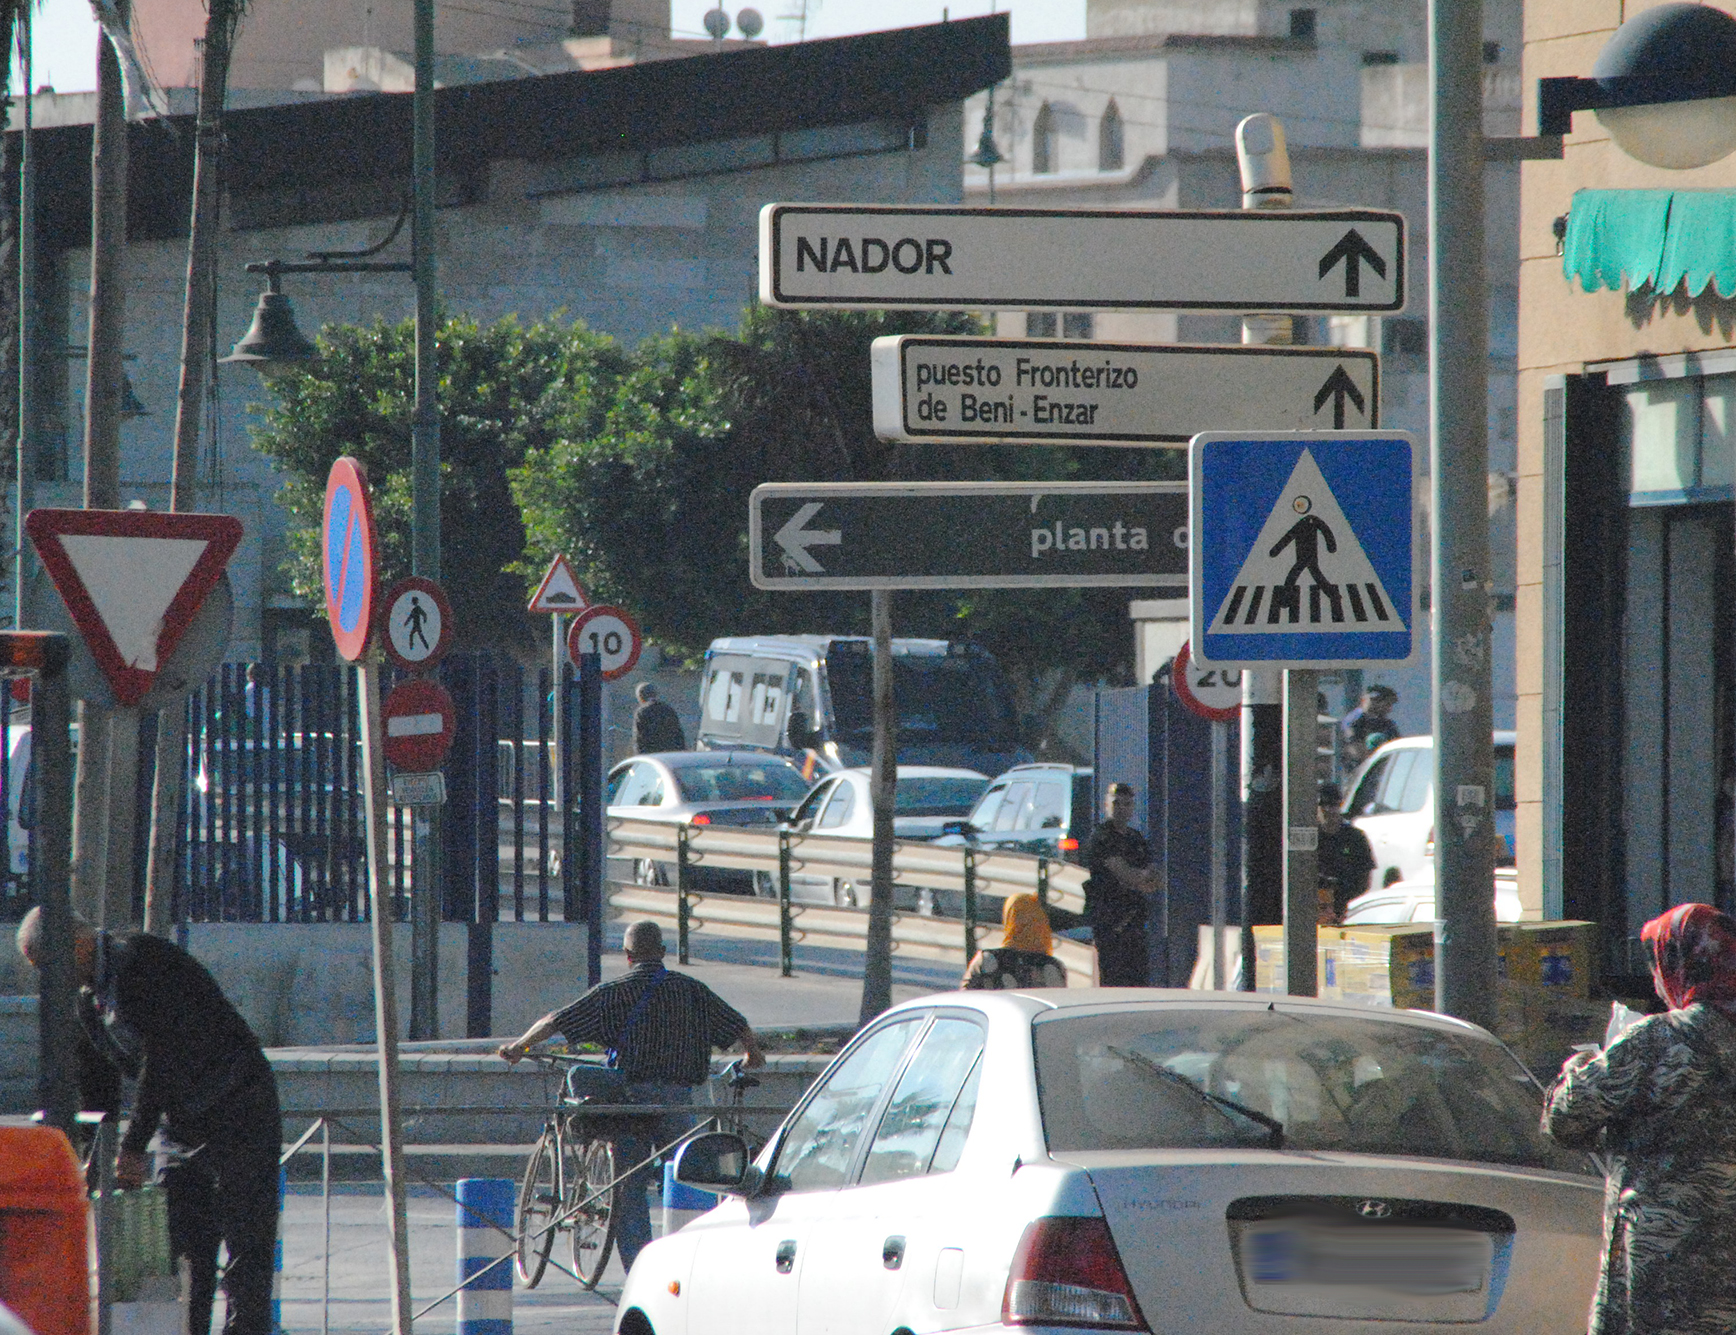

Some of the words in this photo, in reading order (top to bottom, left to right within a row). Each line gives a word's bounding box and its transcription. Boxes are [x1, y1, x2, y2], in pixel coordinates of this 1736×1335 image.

[796, 236, 953, 274] NADOR
[916, 358, 1001, 392] puesto
[1016, 357, 1138, 389] Fronterizo
[917, 392, 947, 421] de
[1031, 520, 1149, 558] planta
[589, 630, 623, 656] 10
